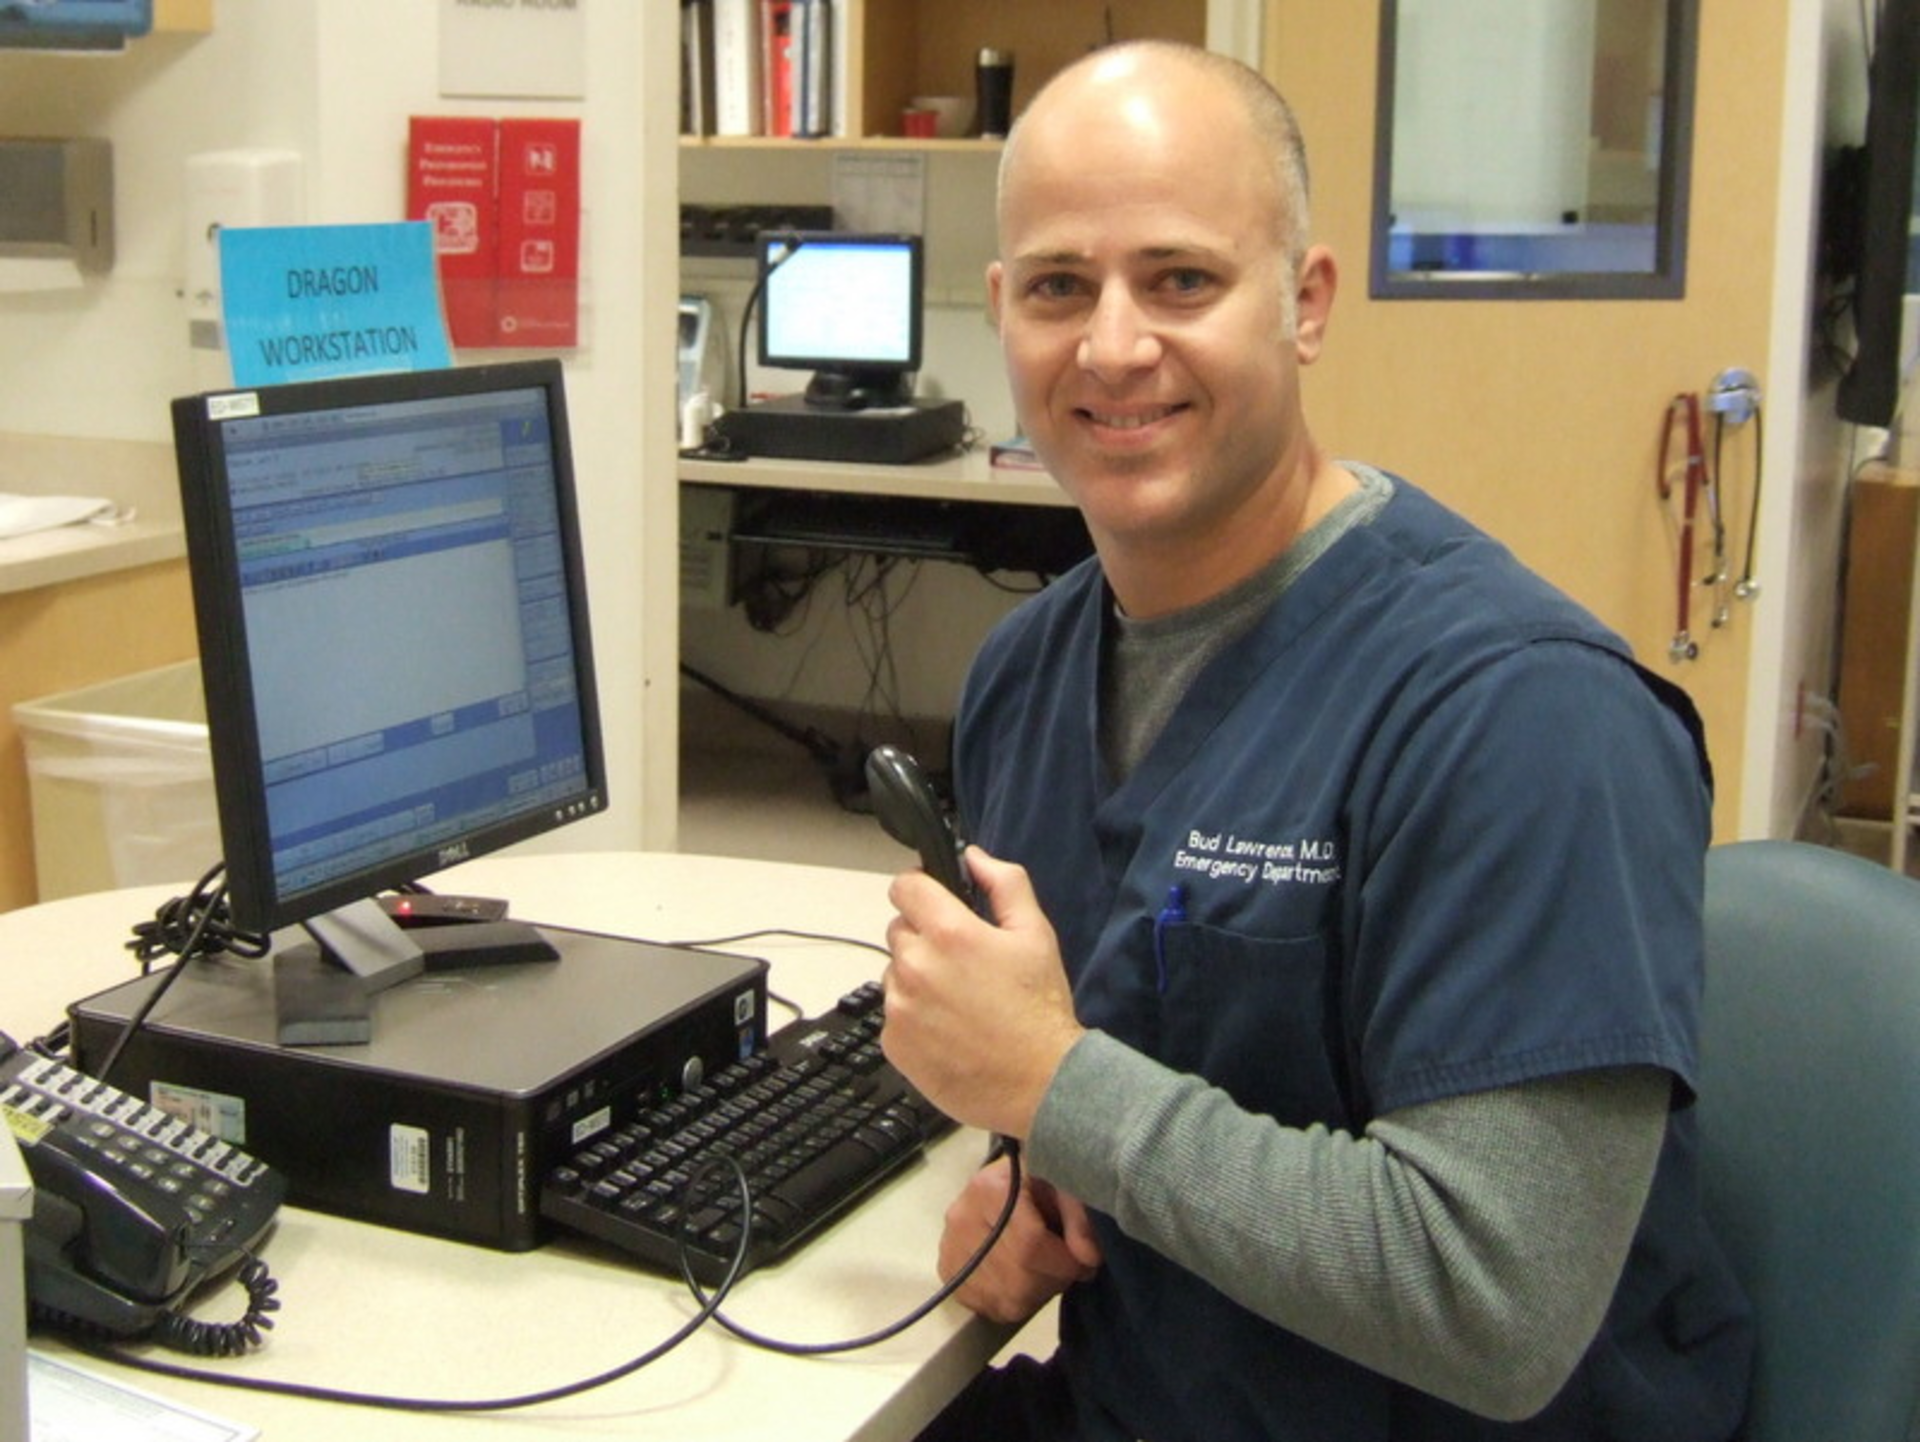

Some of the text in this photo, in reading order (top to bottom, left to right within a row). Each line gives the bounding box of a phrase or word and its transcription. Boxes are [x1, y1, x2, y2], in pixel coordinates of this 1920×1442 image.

[287, 265, 379, 299] DRAGON
[259, 326, 418, 367] WORKSTATION
[1188, 830, 1222, 852] Bud
[1174, 851, 1258, 883] Emergency
